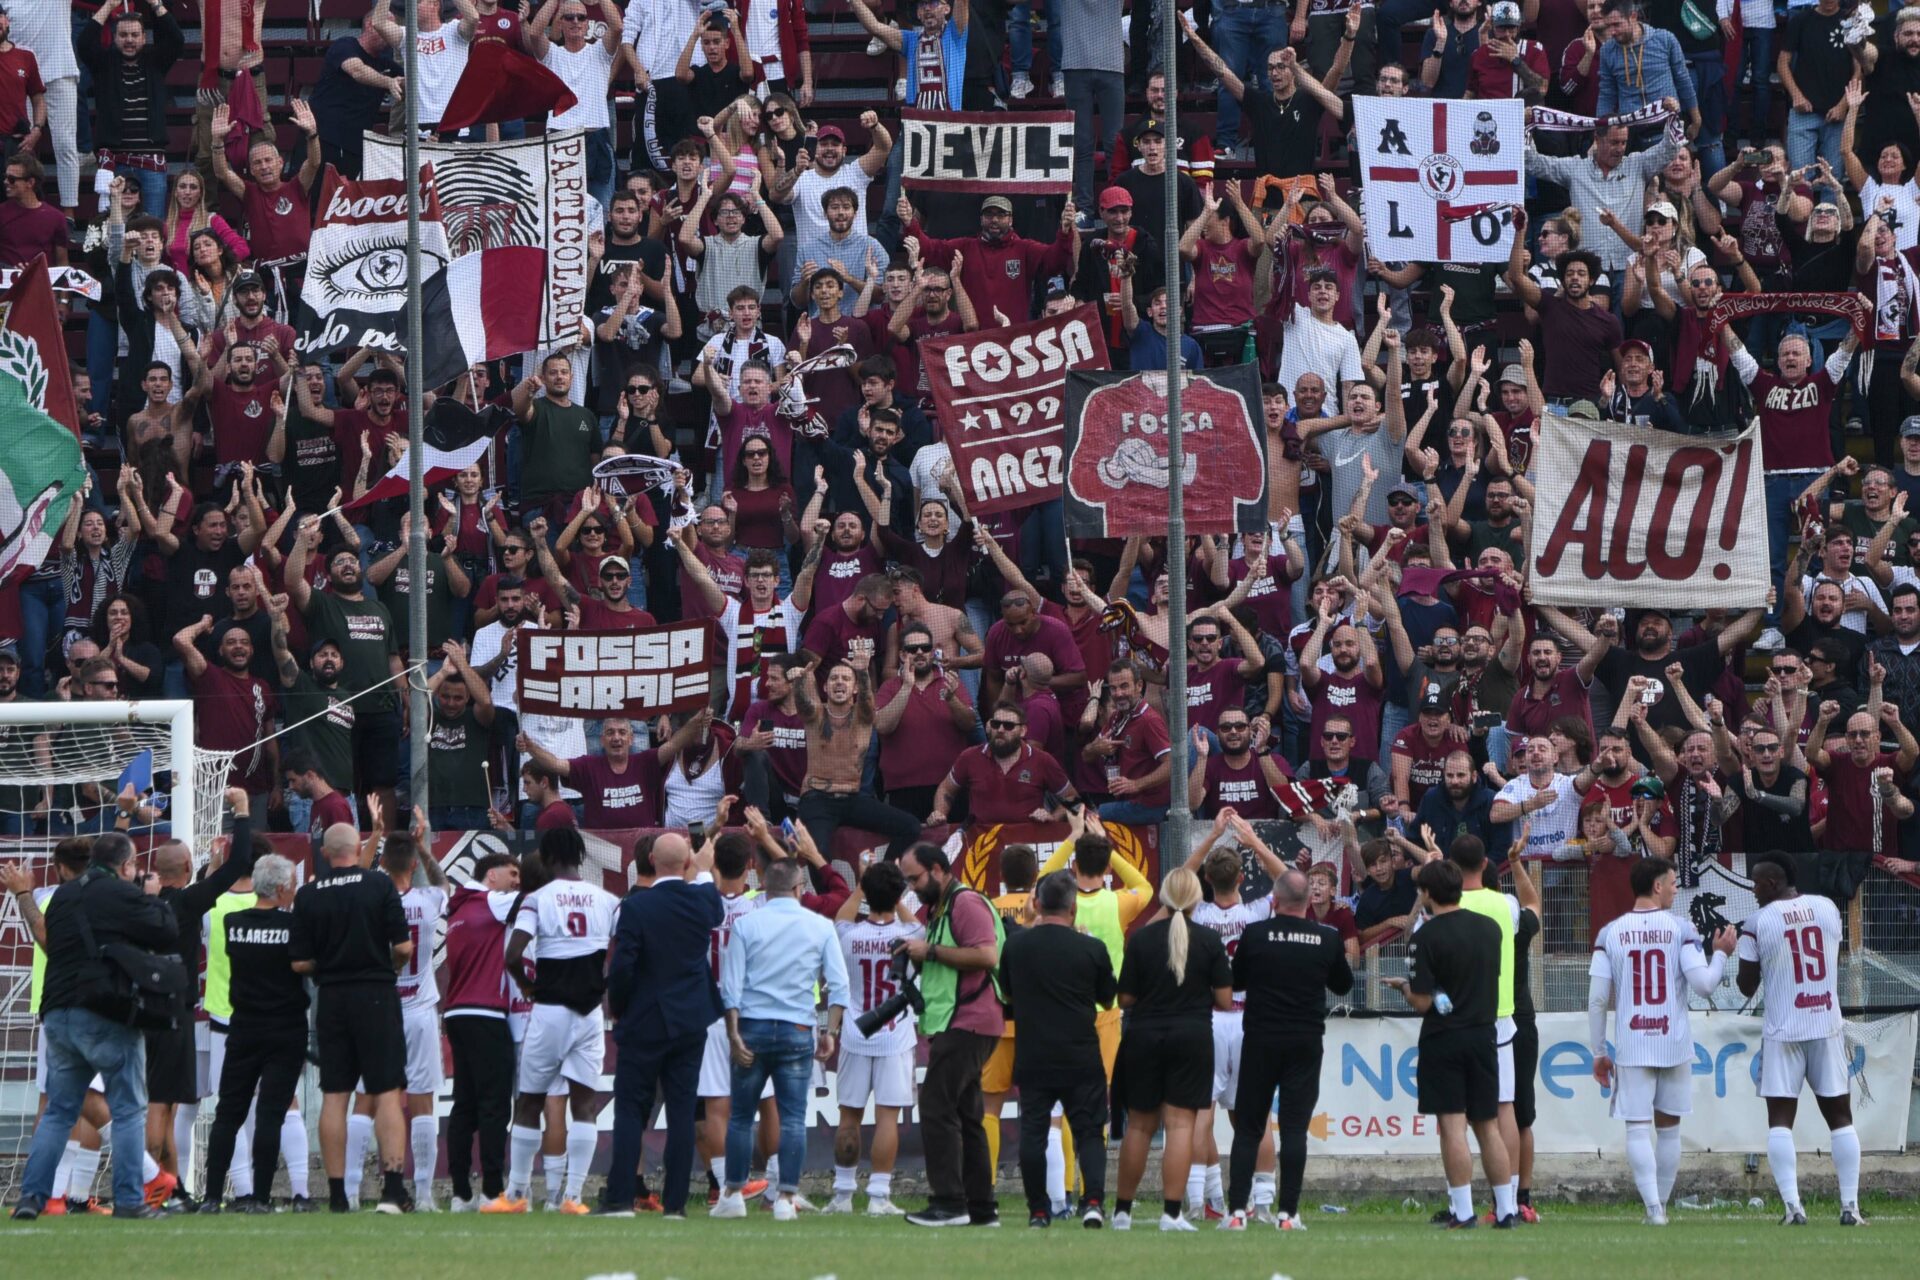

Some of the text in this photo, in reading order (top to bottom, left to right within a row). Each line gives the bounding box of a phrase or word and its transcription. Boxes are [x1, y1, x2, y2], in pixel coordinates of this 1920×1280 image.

[901, 119, 1074, 182] DEVILS
[1377, 118, 1413, 156] A
[551, 138, 584, 338] PARTICOLARI
[1386, 201, 1415, 239] L
[944, 319, 1094, 388] FOSSA
[983, 396, 1061, 430] 199
[1764, 382, 1819, 411] AREZZO
[530, 627, 705, 672] FOSSA
[1783, 908, 1815, 926] DIALLO
[1619, 930, 1673, 946] PATTARELLO
[1783, 925, 1827, 985] 19
[1628, 948, 1667, 1007] 10
[1341, 1115, 1402, 1138] GAS
[1412, 1115, 1426, 1137] E
